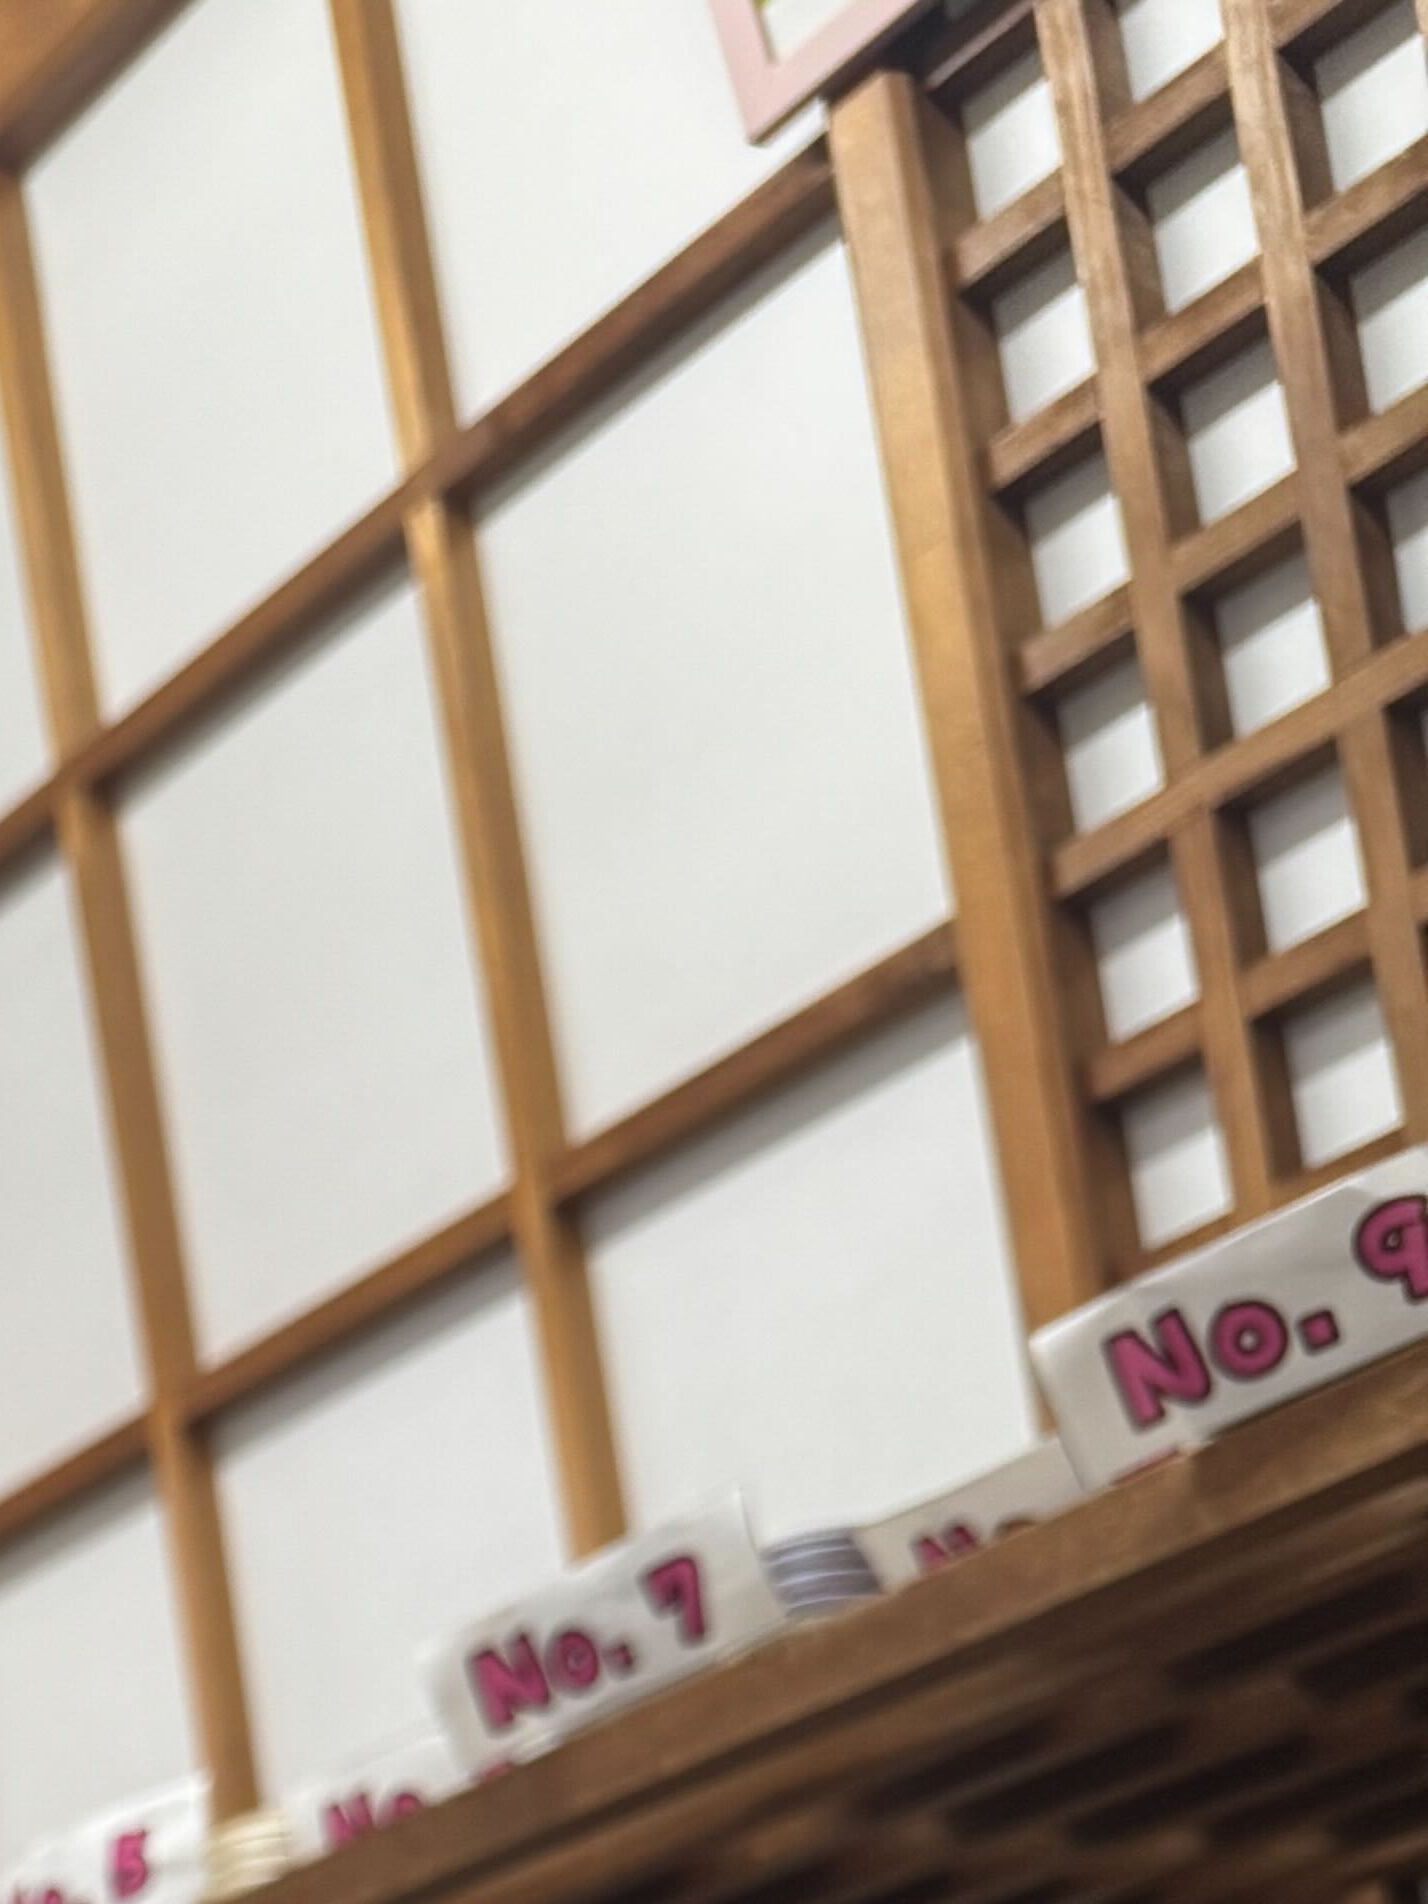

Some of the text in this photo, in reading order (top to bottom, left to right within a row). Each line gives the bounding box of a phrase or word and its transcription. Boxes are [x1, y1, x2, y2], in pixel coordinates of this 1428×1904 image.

[1103, 1194, 1428, 1432] No. 9
[466, 1550, 707, 1736] No. 7
